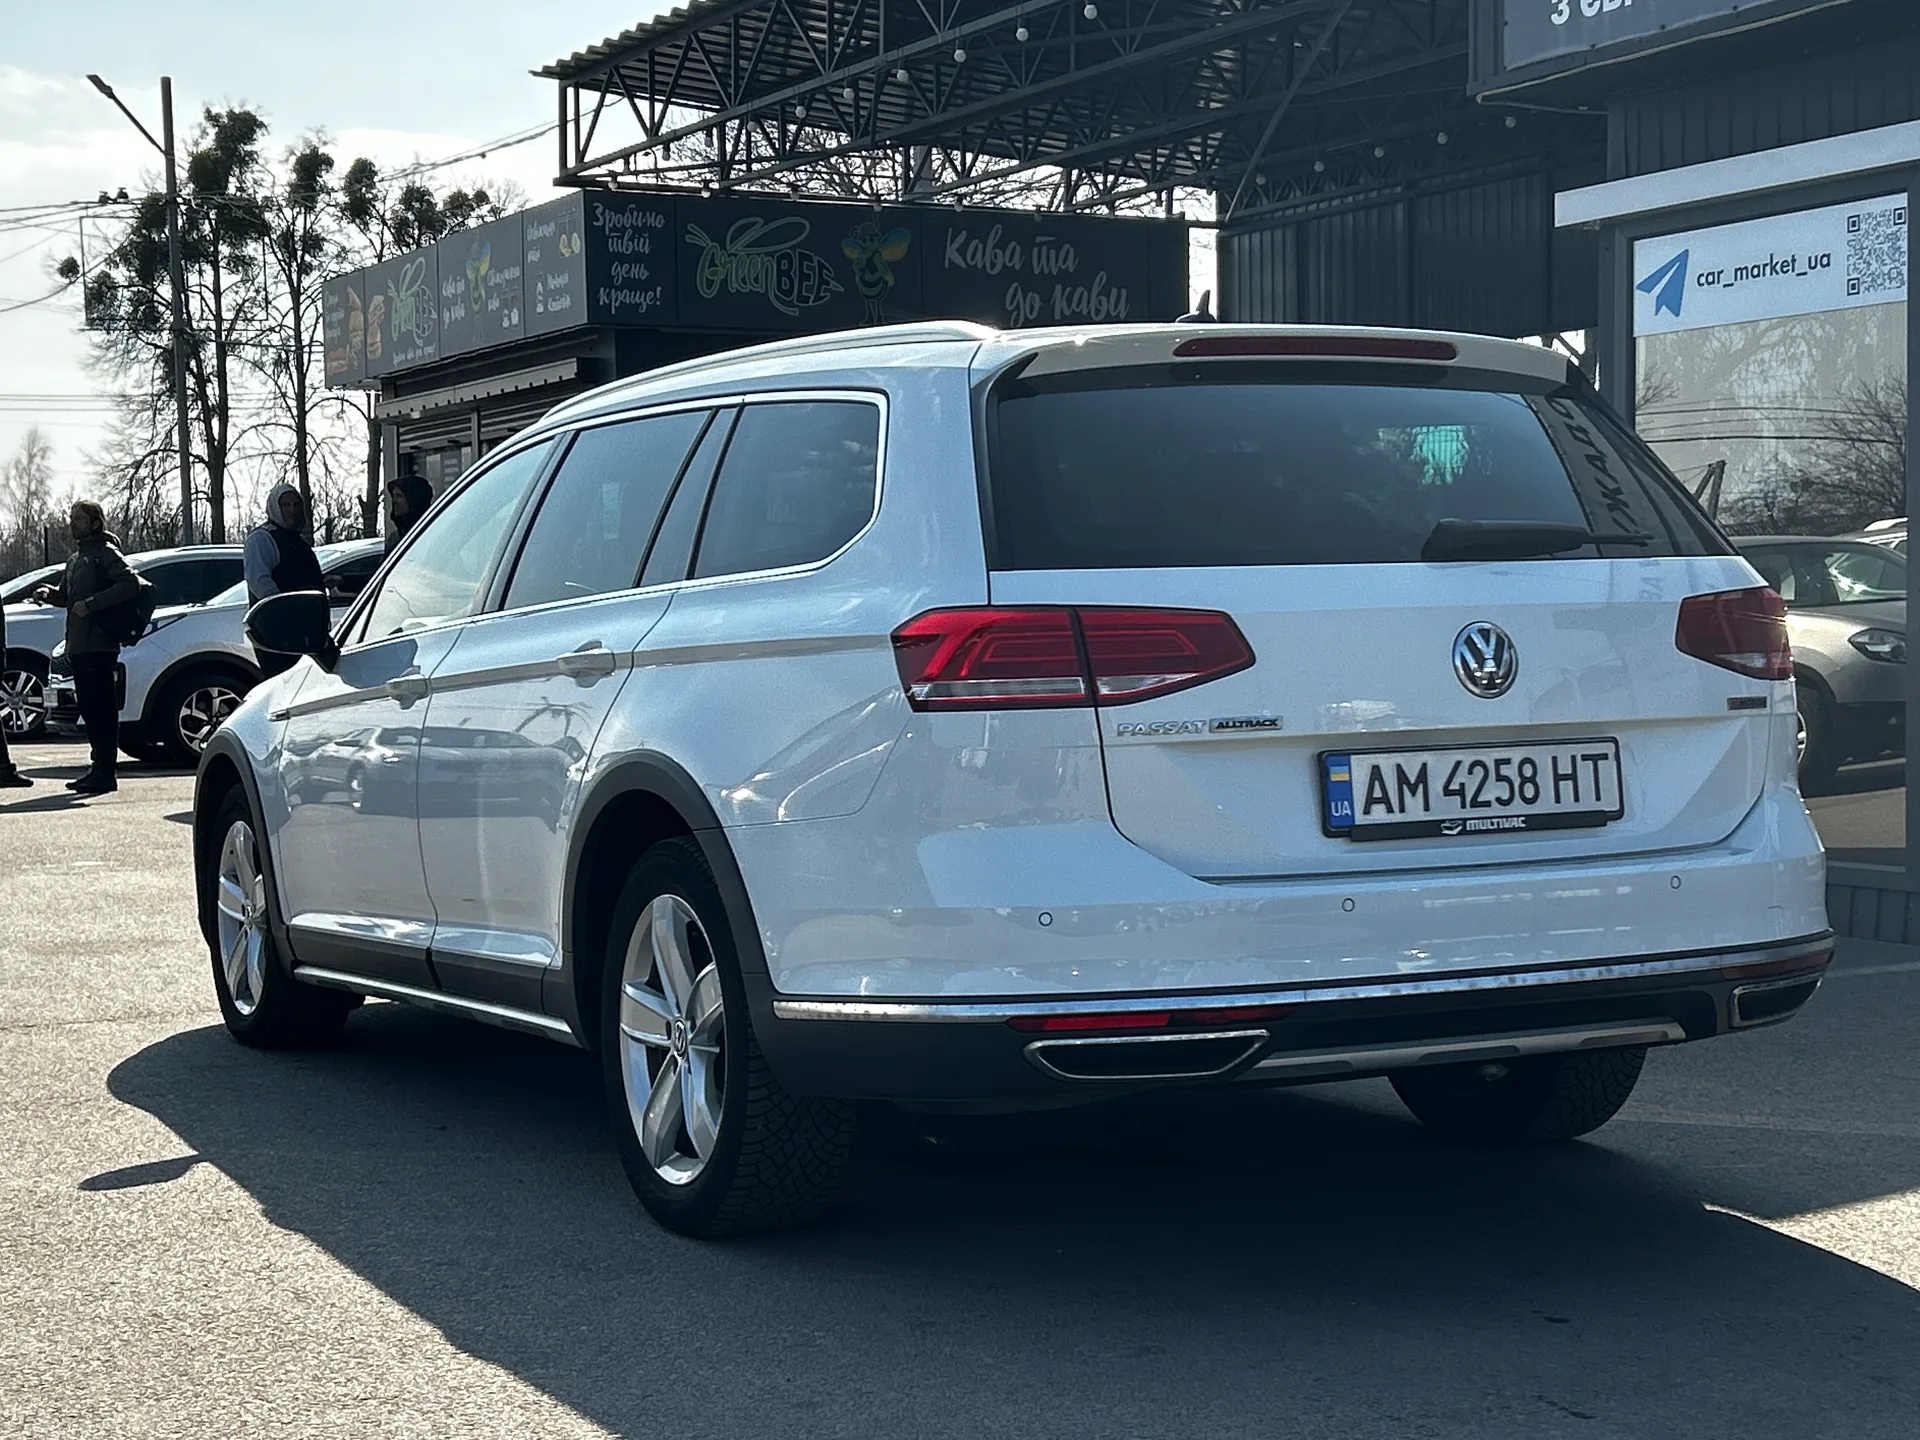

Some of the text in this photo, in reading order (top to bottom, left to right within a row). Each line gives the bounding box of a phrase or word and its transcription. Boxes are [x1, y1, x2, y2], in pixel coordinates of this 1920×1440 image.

[593, 202, 665, 235] Зробимо
[608, 228, 651, 254] твій
[944, 224, 1079, 275] Кава та
[611, 261, 650, 286] день
[1696, 252, 1831, 288] car_market_ua
[598, 286, 662, 315] краще!
[1005, 271, 1130, 328] до кави
[1117, 719, 1279, 736] PASSAT ALLTRACK
[1362, 753, 1609, 815] AM 4258 HT
[1331, 800, 1351, 817] UA
[1466, 817, 1526, 831] MULTIVAC
